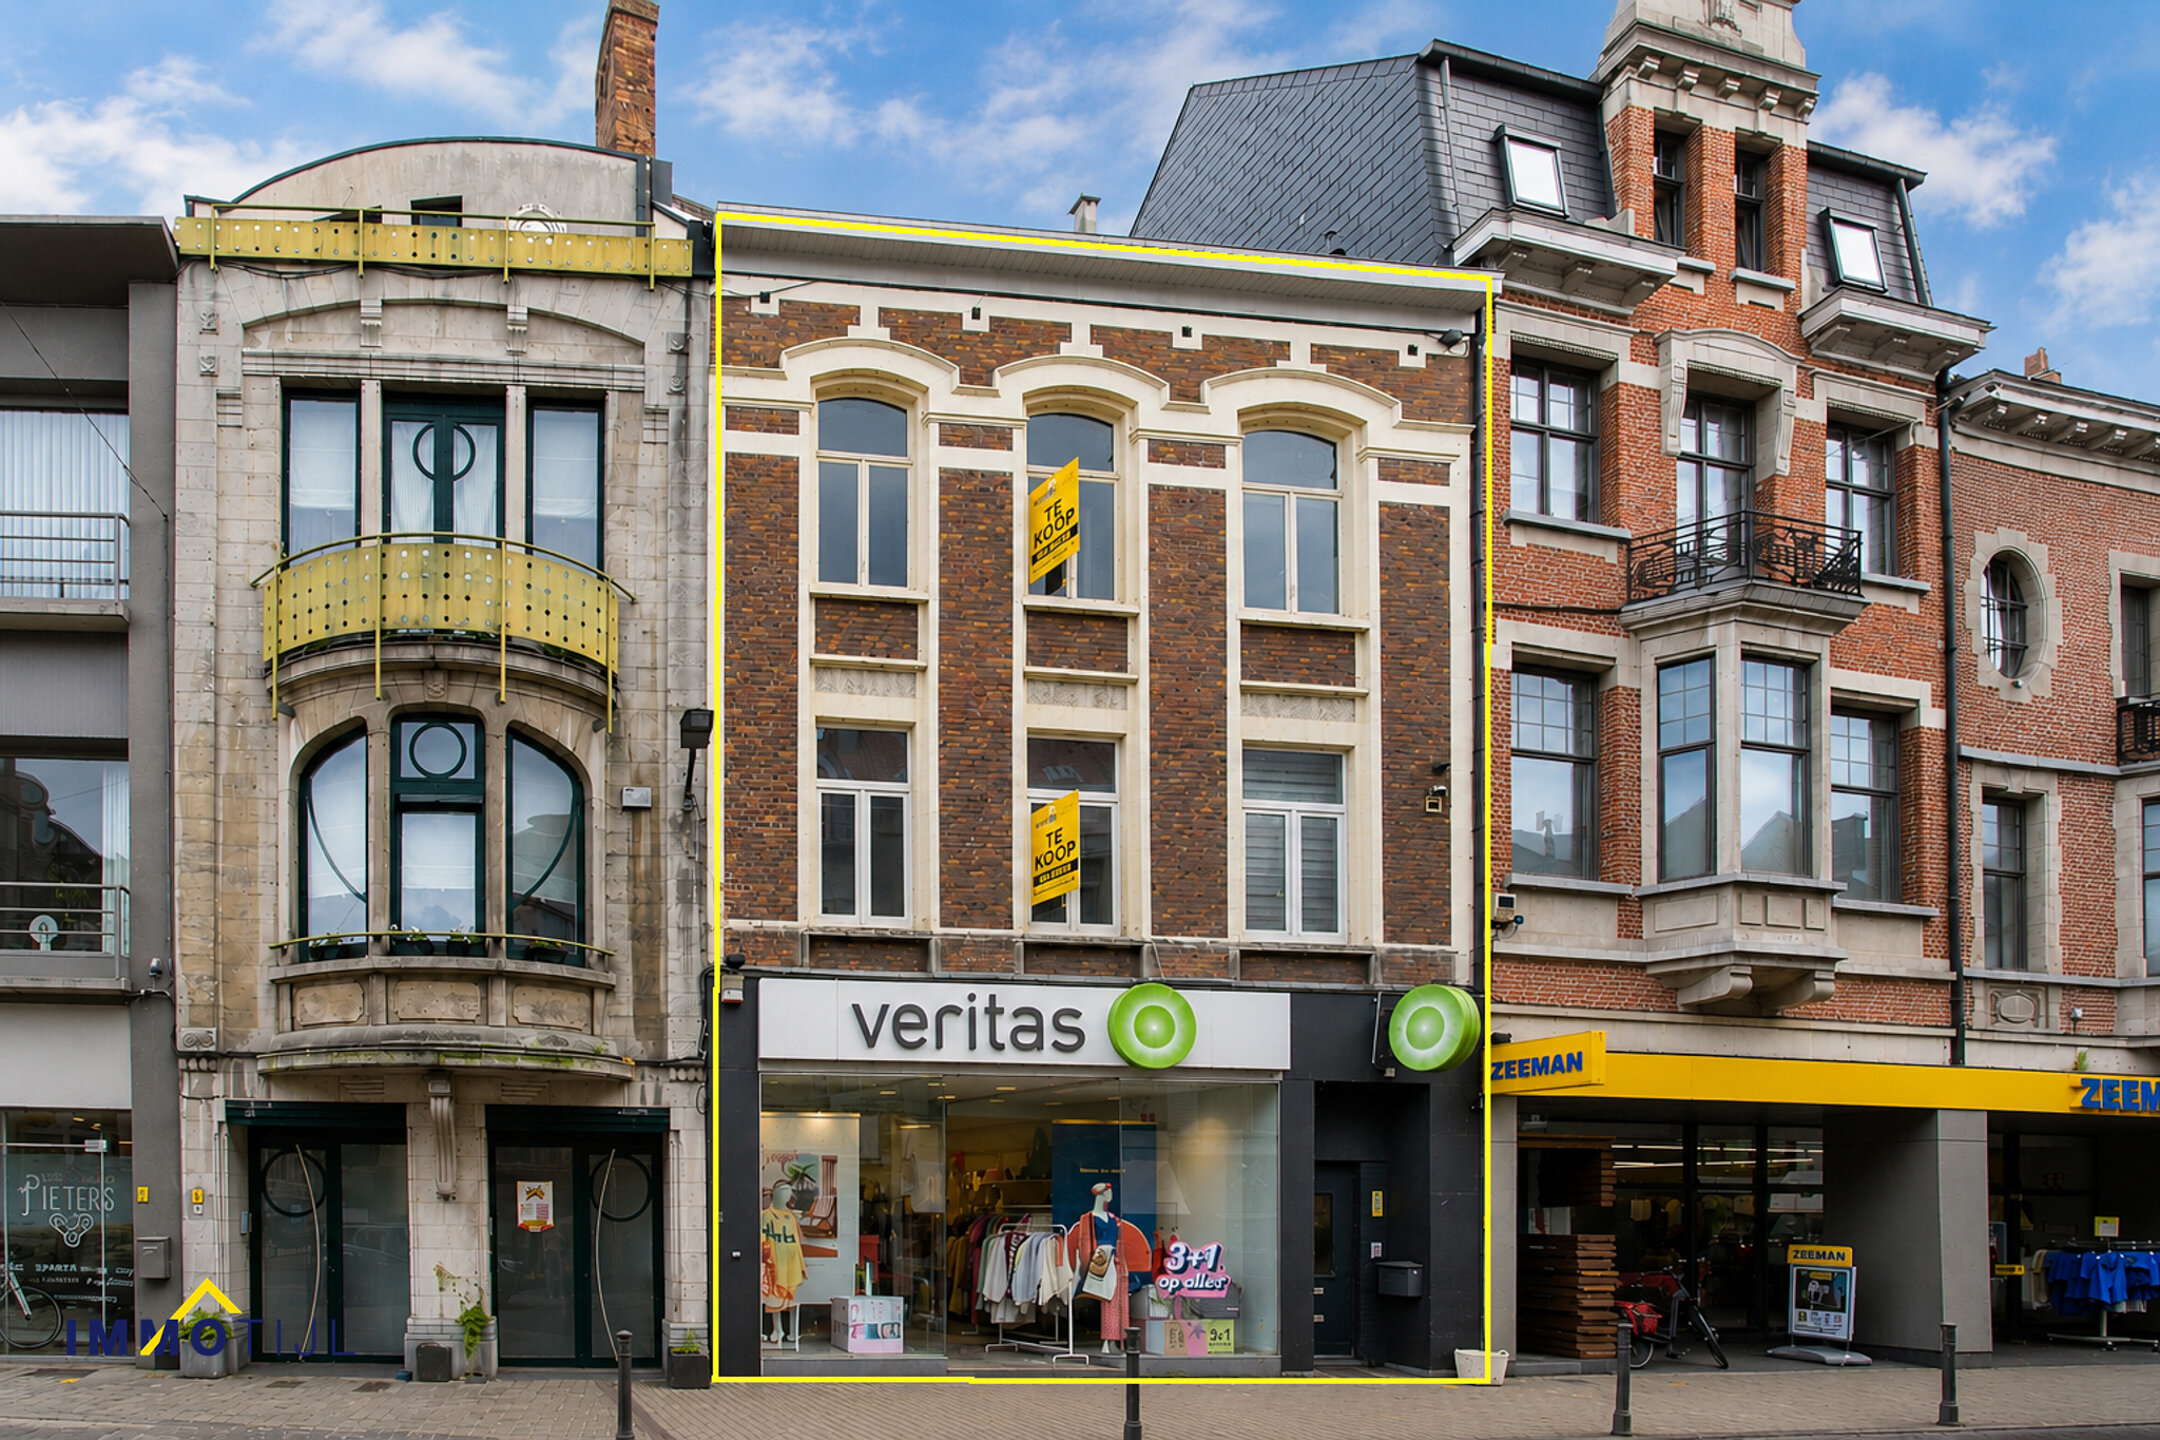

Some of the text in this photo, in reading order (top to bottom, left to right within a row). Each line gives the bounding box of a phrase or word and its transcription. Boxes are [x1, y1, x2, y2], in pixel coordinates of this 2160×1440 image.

[1044, 498, 1063, 522] TE
[1034, 507, 1075, 549] KOOP
[1046, 827, 1063, 848] TE
[1034, 840, 1076, 872] KOOP
[851, 992, 1087, 1053] veritas
[1490, 1051, 1583, 1081] ZEEMAN
[17, 1174, 116, 1216] PIETERS
[1166, 1242, 1222, 1275] 3+1
[1792, 1249, 1846, 1262] ZEEMAN
[1158, 1278, 1184, 1295] op
